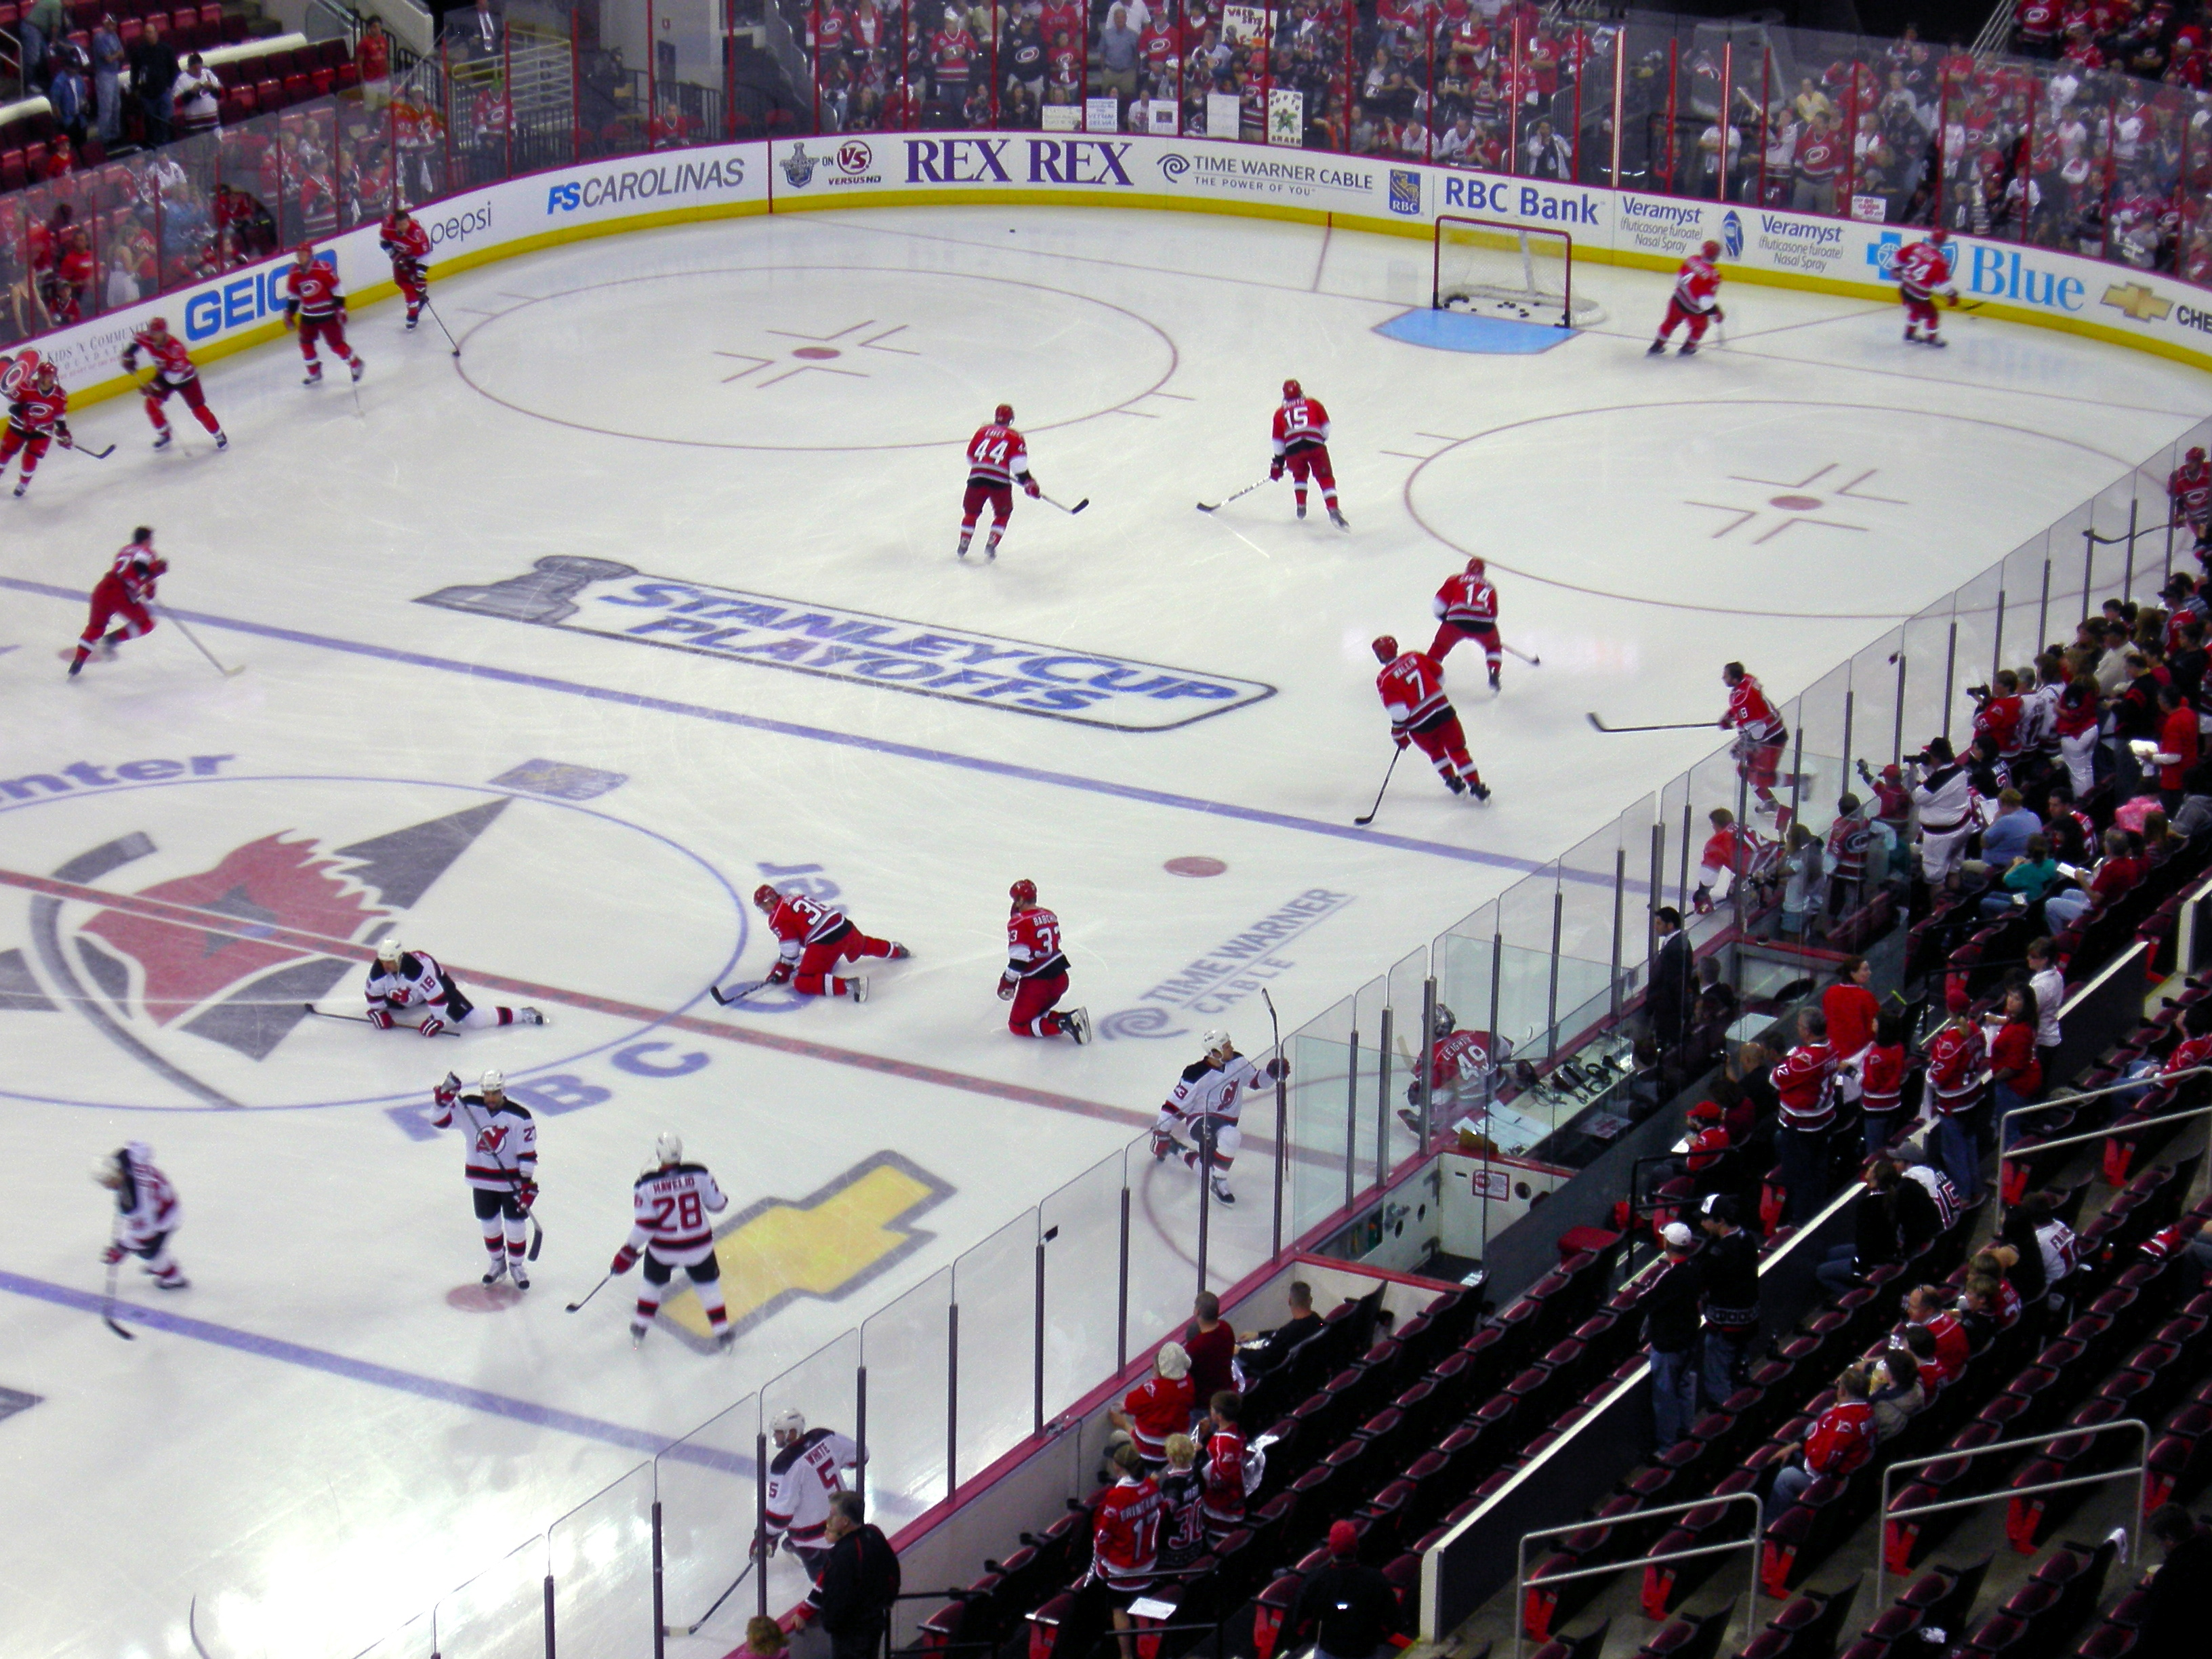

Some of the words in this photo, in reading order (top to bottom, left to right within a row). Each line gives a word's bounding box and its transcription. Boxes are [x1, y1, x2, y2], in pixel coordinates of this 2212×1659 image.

[822, 156, 834, 166] ON
[903, 138, 1012, 183] REX
[1025, 139, 1134, 186] REX
[1193, 155, 1237, 173] TIME
[1242, 160, 1315, 182] WARNER
[1319, 169, 1373, 190] CABLE
[583, 158, 744, 207] CAROLINAS
[1194, 176, 1215, 186] THE
[1223, 179, 1263, 190] POWER
[1269, 182, 1283, 192] OF
[1289, 185, 1311, 196] YOU
[1393, 201, 1417, 212] RBC
[1446, 177, 1508, 213] RBC
[1520, 186, 1599, 226] Bank
[1622, 196, 1702, 226] Veramyst
[430, 201, 493, 251] pepsi
[1762, 214, 1843, 245] Veramyst
[1635, 233, 1660, 249] Nasal
[1662, 237, 1687, 255] Spray
[1774, 252, 1799, 267] Nasal
[1800, 257, 1828, 274] Spray
[1967, 244, 2085, 312] Blue
[47, 346, 73, 364] KIDS
[1284, 407, 1309, 430] 15
[974, 438, 1010, 466] 44
[1466, 583, 1493, 609] 14
[597, 583, 1042, 665] STANLEY
[1017, 656, 1237, 700] CUP
[625, 615, 1111, 710] PLAYOFFS
[1405, 668, 1425, 701] 7
[0, 754, 236, 802] nter
[1139, 958, 1236, 1003] TIME
[1207, 888, 1349, 960] WARNER
[419, 975, 436, 993] 18
[1193, 957, 1295, 1014] CABLE
[1457, 1044, 1490, 1081] 49
[651, 1190, 703, 1233] 28
[803, 1441, 832, 1467] WHITE
[1133, 1507, 1161, 1561] 17
